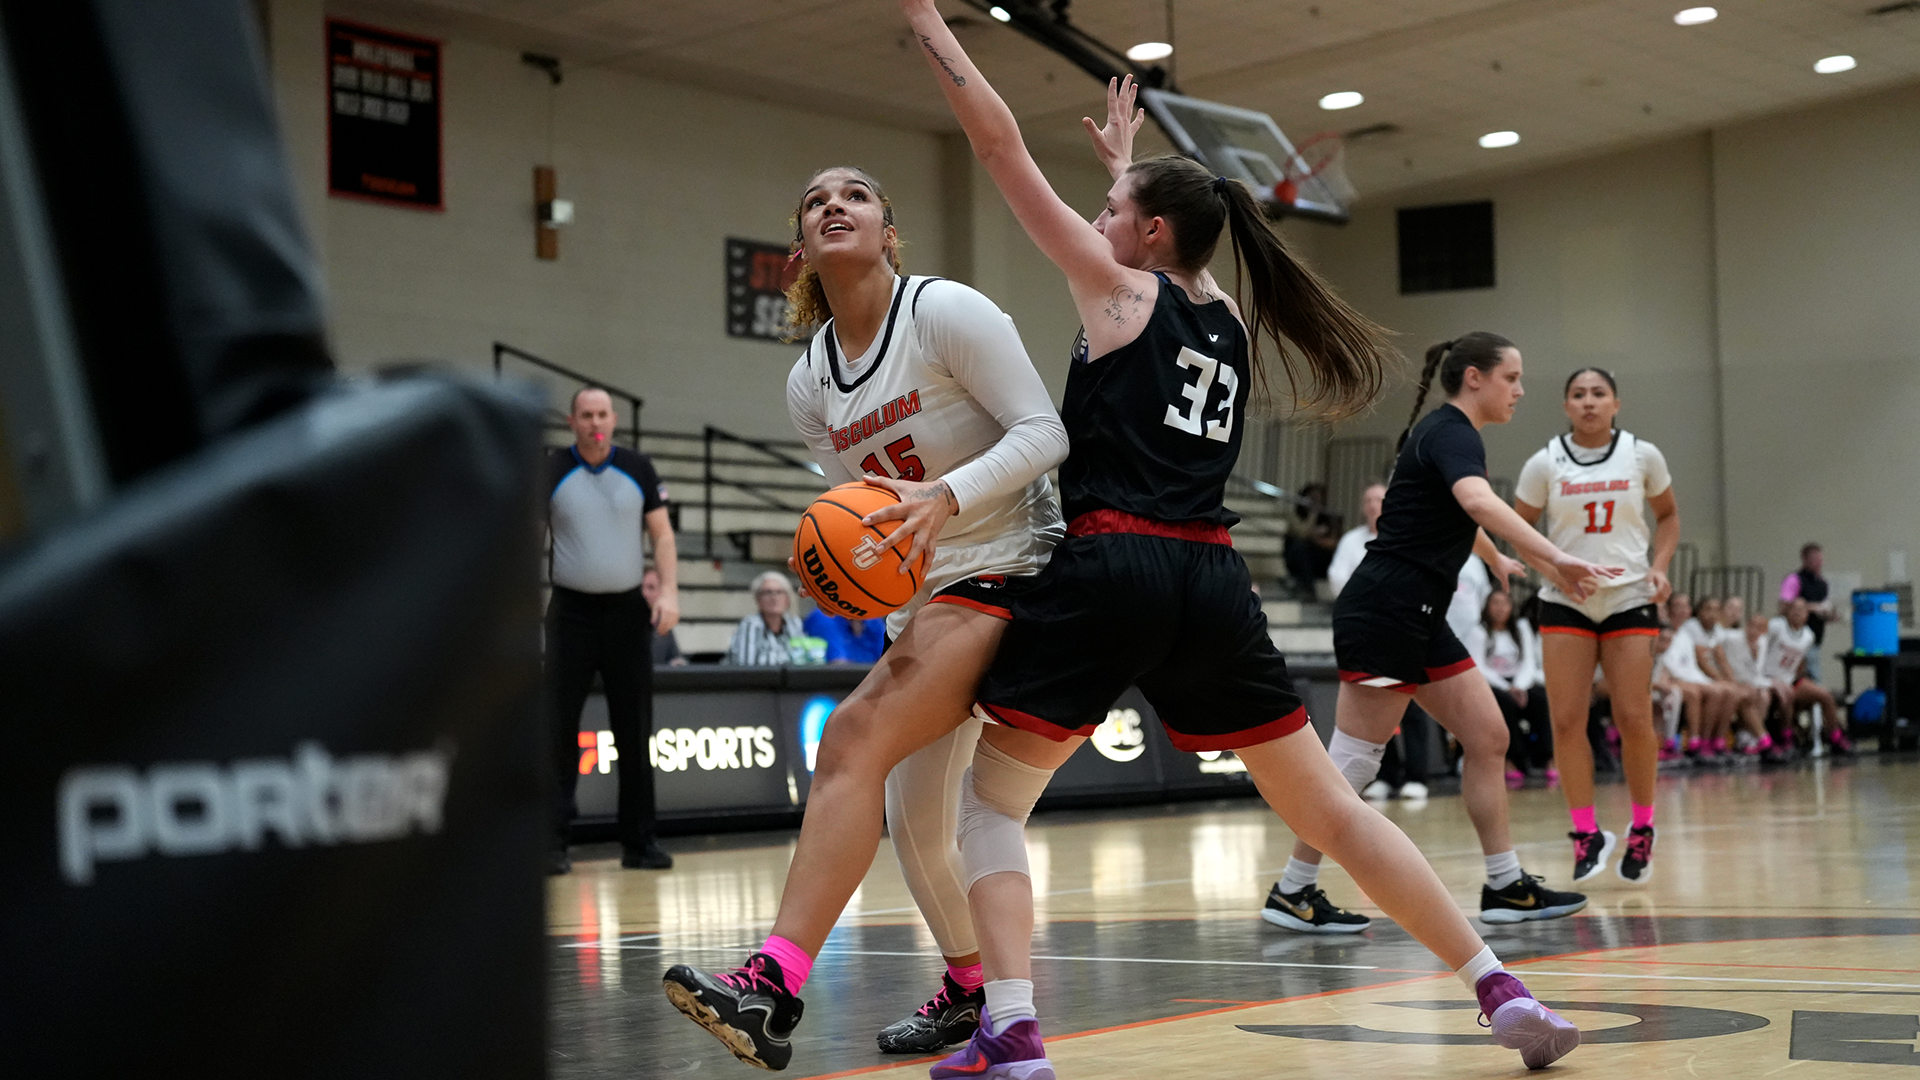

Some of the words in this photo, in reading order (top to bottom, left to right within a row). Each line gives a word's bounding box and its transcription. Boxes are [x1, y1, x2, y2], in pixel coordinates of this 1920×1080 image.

[1163, 345, 1239, 443] 33
[860, 434, 925, 482] 15
[1584, 500, 1615, 533] 11
[803, 544, 868, 617] Wilson
[597, 726, 776, 775] FSPORTS
